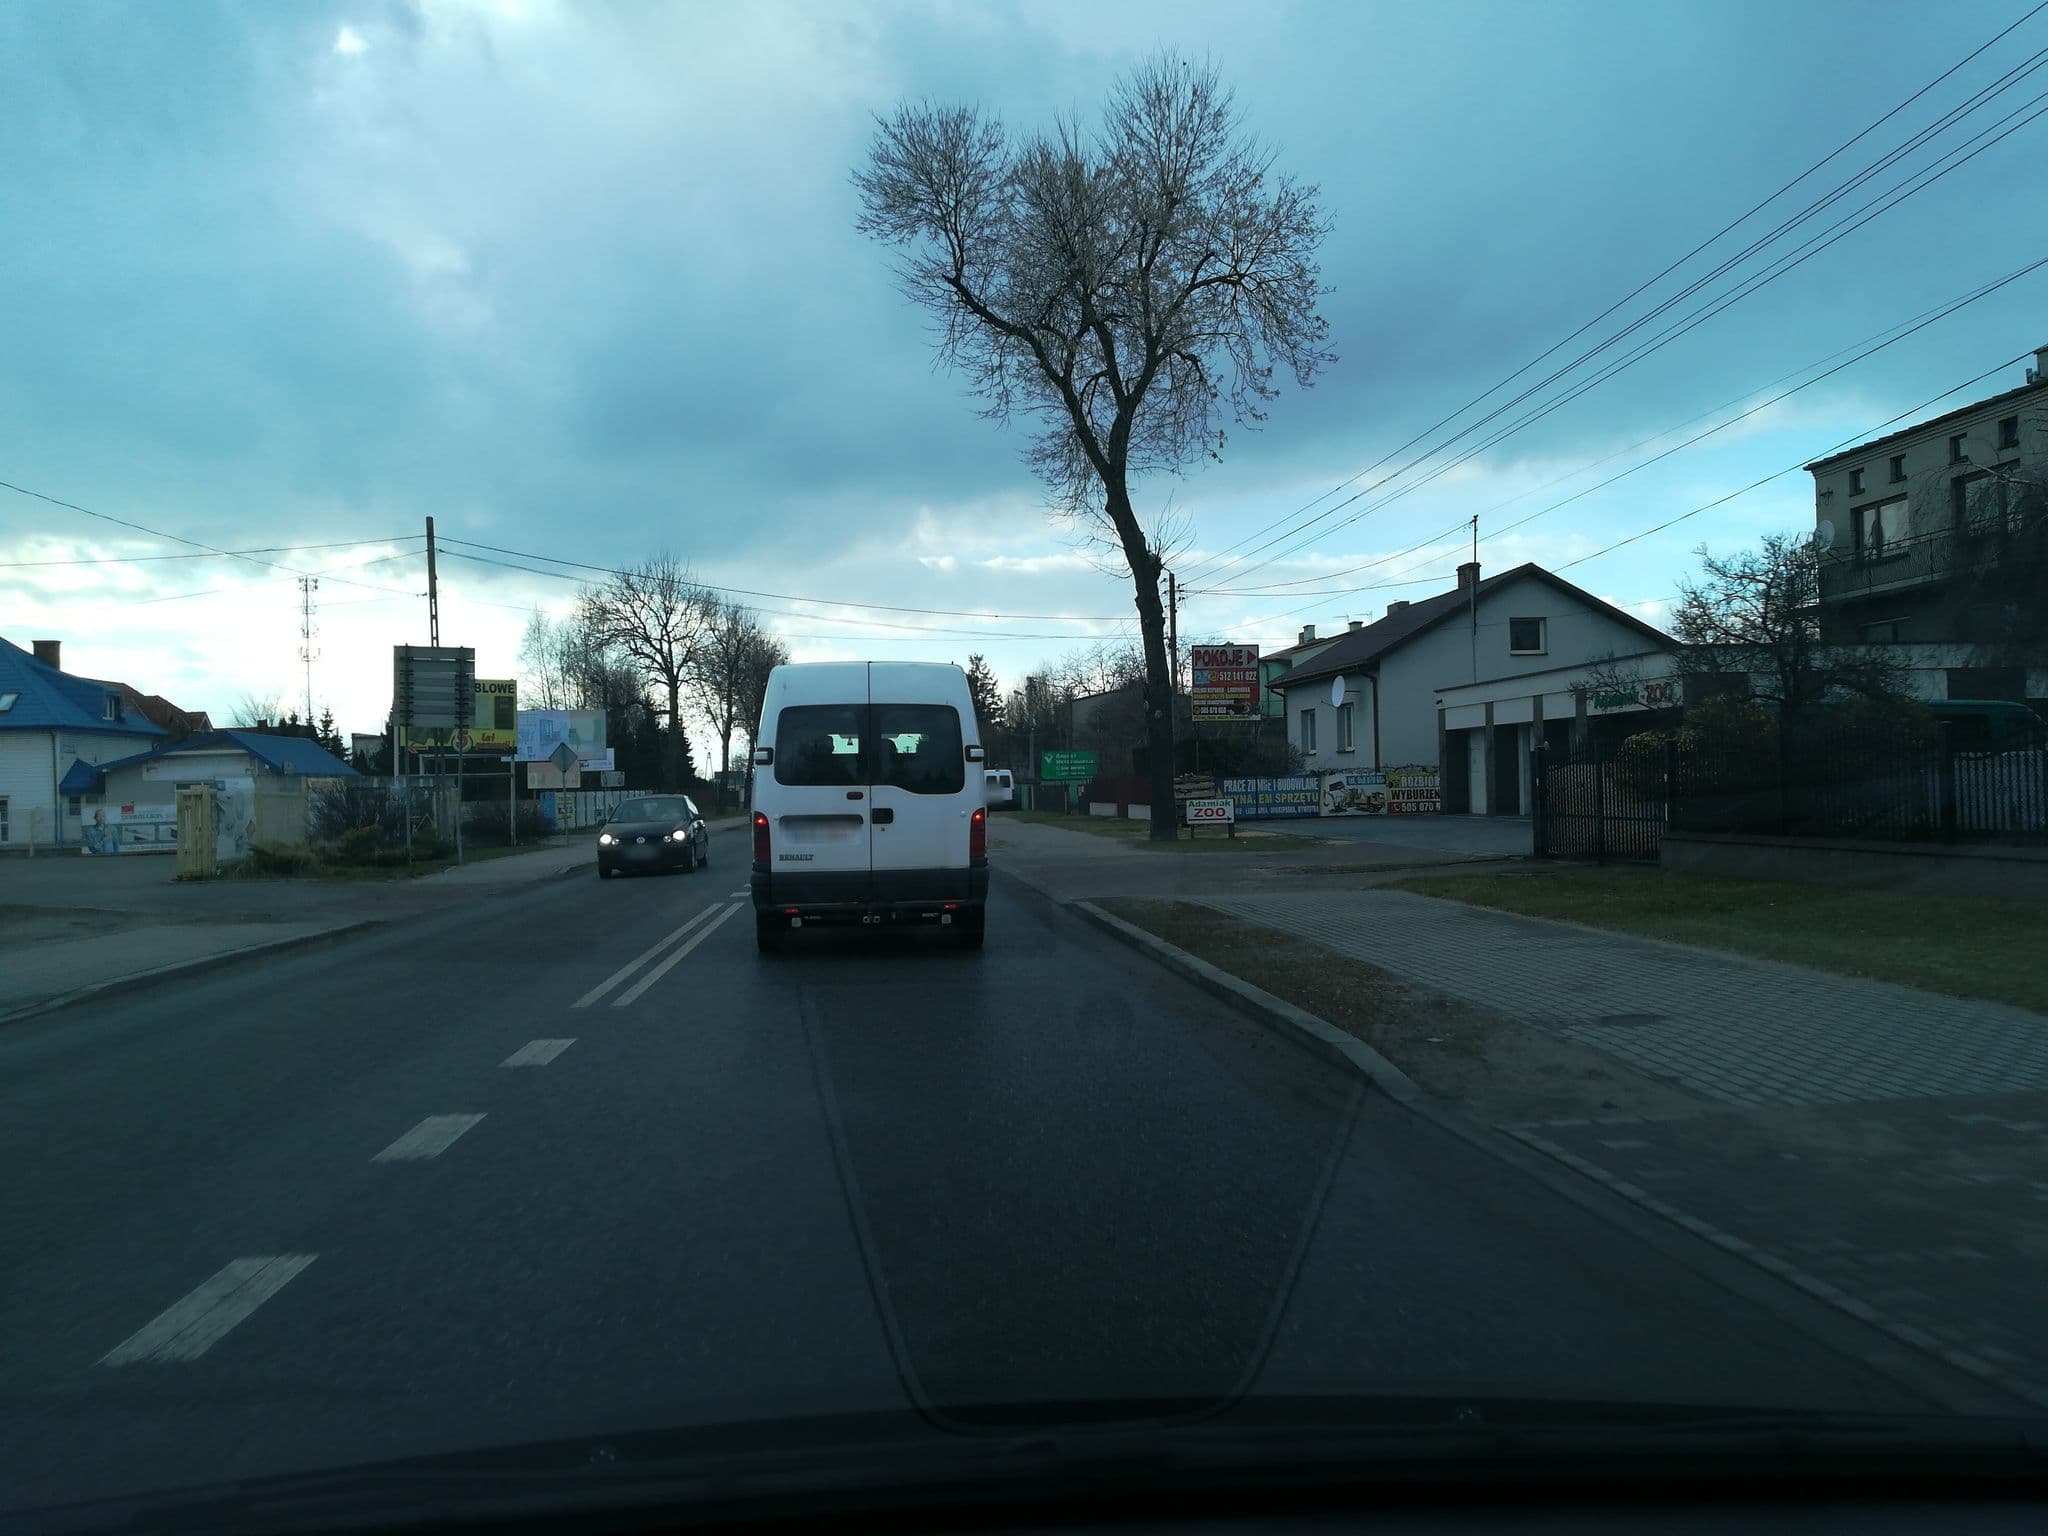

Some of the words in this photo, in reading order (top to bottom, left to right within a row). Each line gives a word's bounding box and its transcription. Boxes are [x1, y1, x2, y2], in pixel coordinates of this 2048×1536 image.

[1194, 649, 1244, 667] POKOJE
[1219, 671, 1232, 681] 512
[1223, 779, 1246, 793] PRACE
[1277, 777, 1319, 792] BUDOWLANE
[1188, 799, 1231, 808] Adamiak
[1275, 792, 1319, 805] SPRZĘTU
[1193, 807, 1226, 818] ZOO
